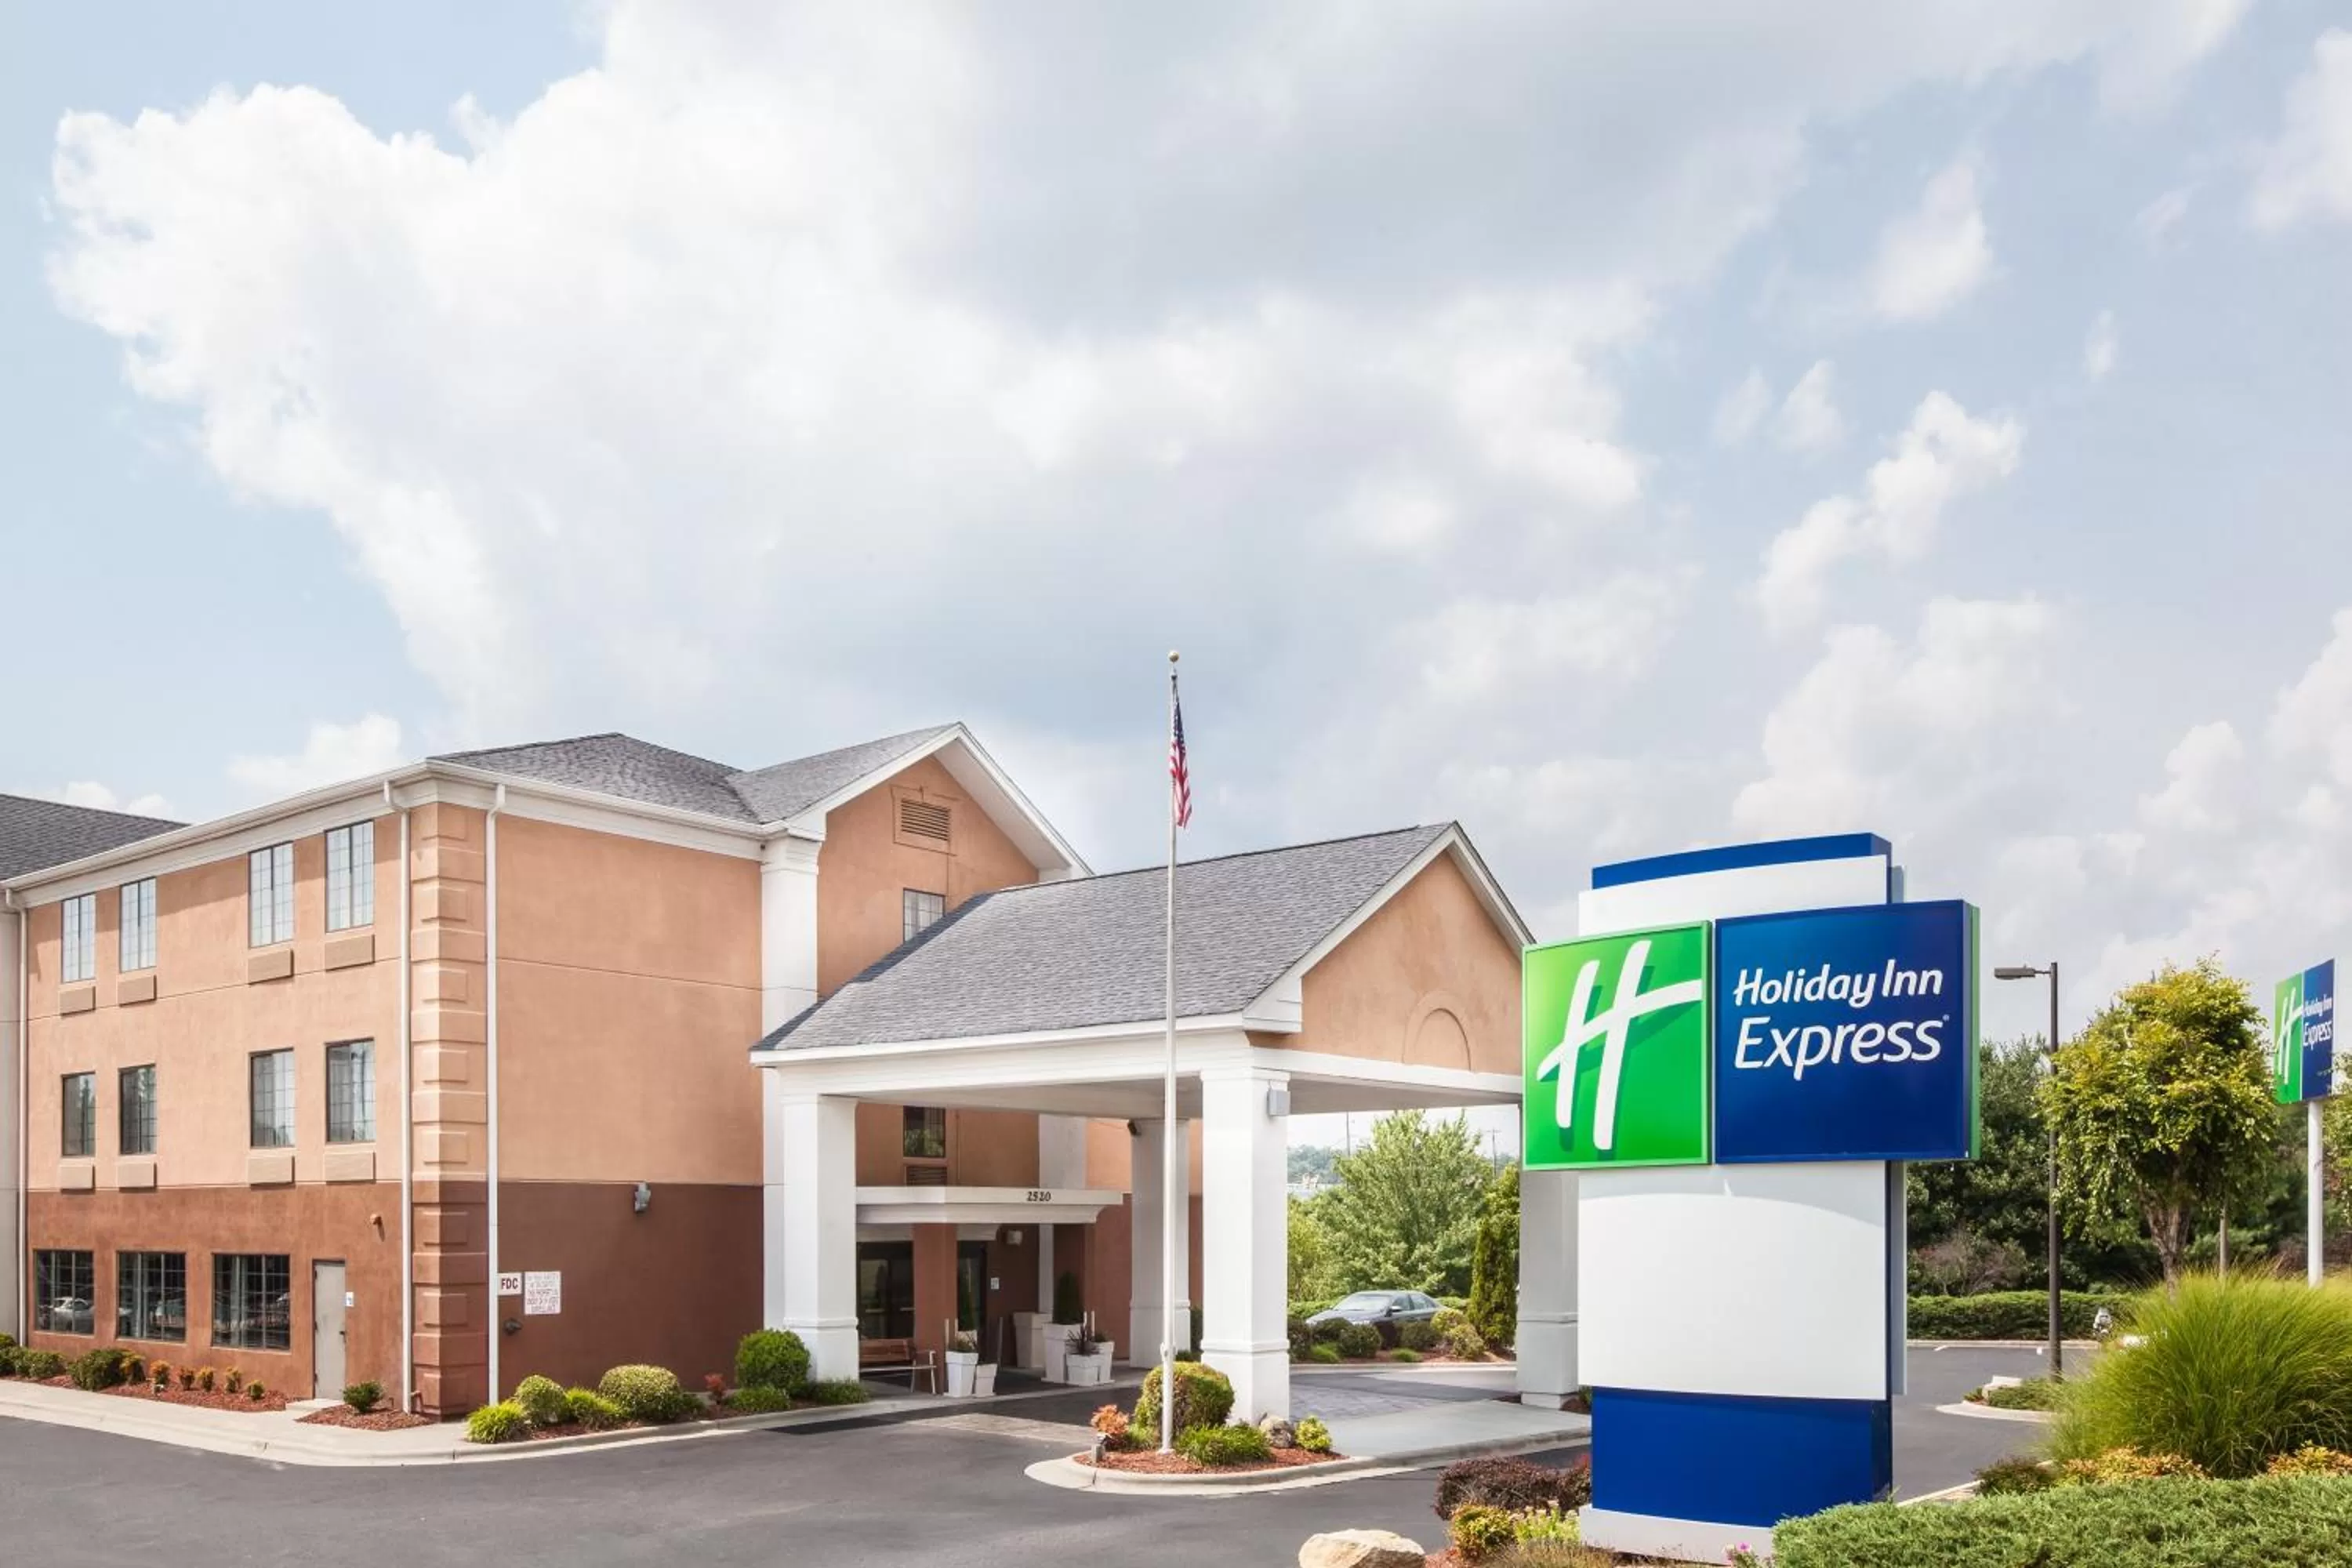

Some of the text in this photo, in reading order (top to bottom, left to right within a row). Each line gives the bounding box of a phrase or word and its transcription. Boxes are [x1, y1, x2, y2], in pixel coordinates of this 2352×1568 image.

[1733, 959, 1944, 1009] Holiday Inn
[1536, 939, 1704, 1151] H
[1734, 1015, 1944, 1081] Express
[2303, 1022, 2332, 1051] Express
[1027, 1191, 1051, 1202] 2520
[501, 1277, 518, 1290] FDC
